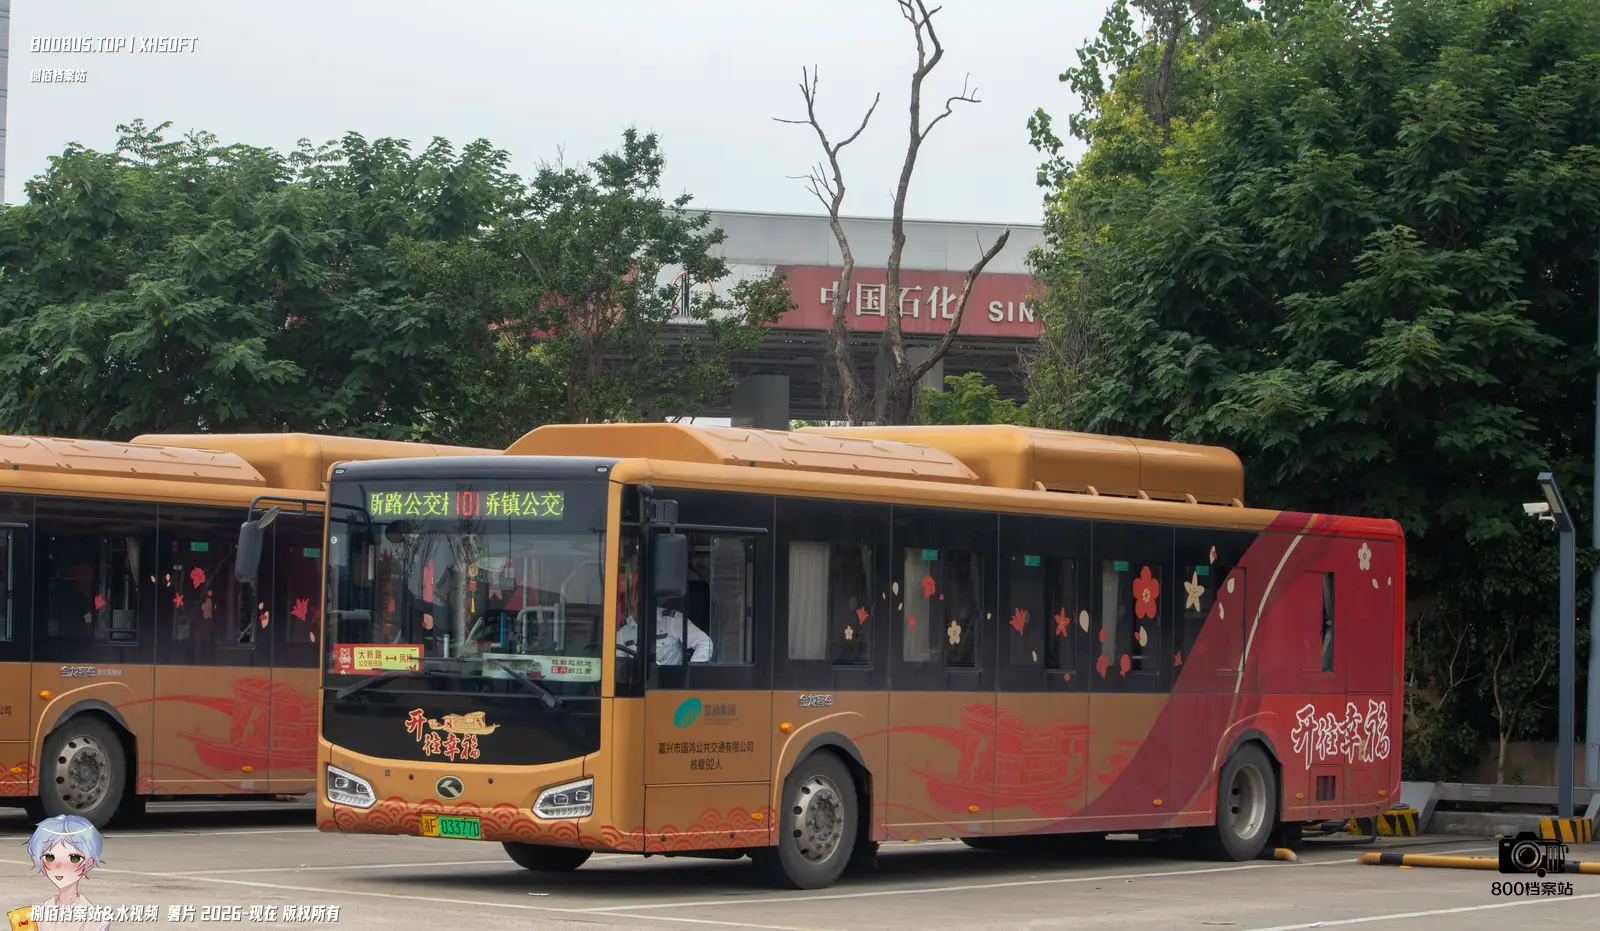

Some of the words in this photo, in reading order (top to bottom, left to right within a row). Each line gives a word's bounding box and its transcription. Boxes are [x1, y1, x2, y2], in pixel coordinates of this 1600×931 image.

[820, 280, 957, 319] 中国石化
[456, 491, 481, 517] 101
[486, 491, 565, 516] 桥镇公交
[358, 649, 382, 660] 大新路
[1290, 698, 1391, 770] 开往幸福
